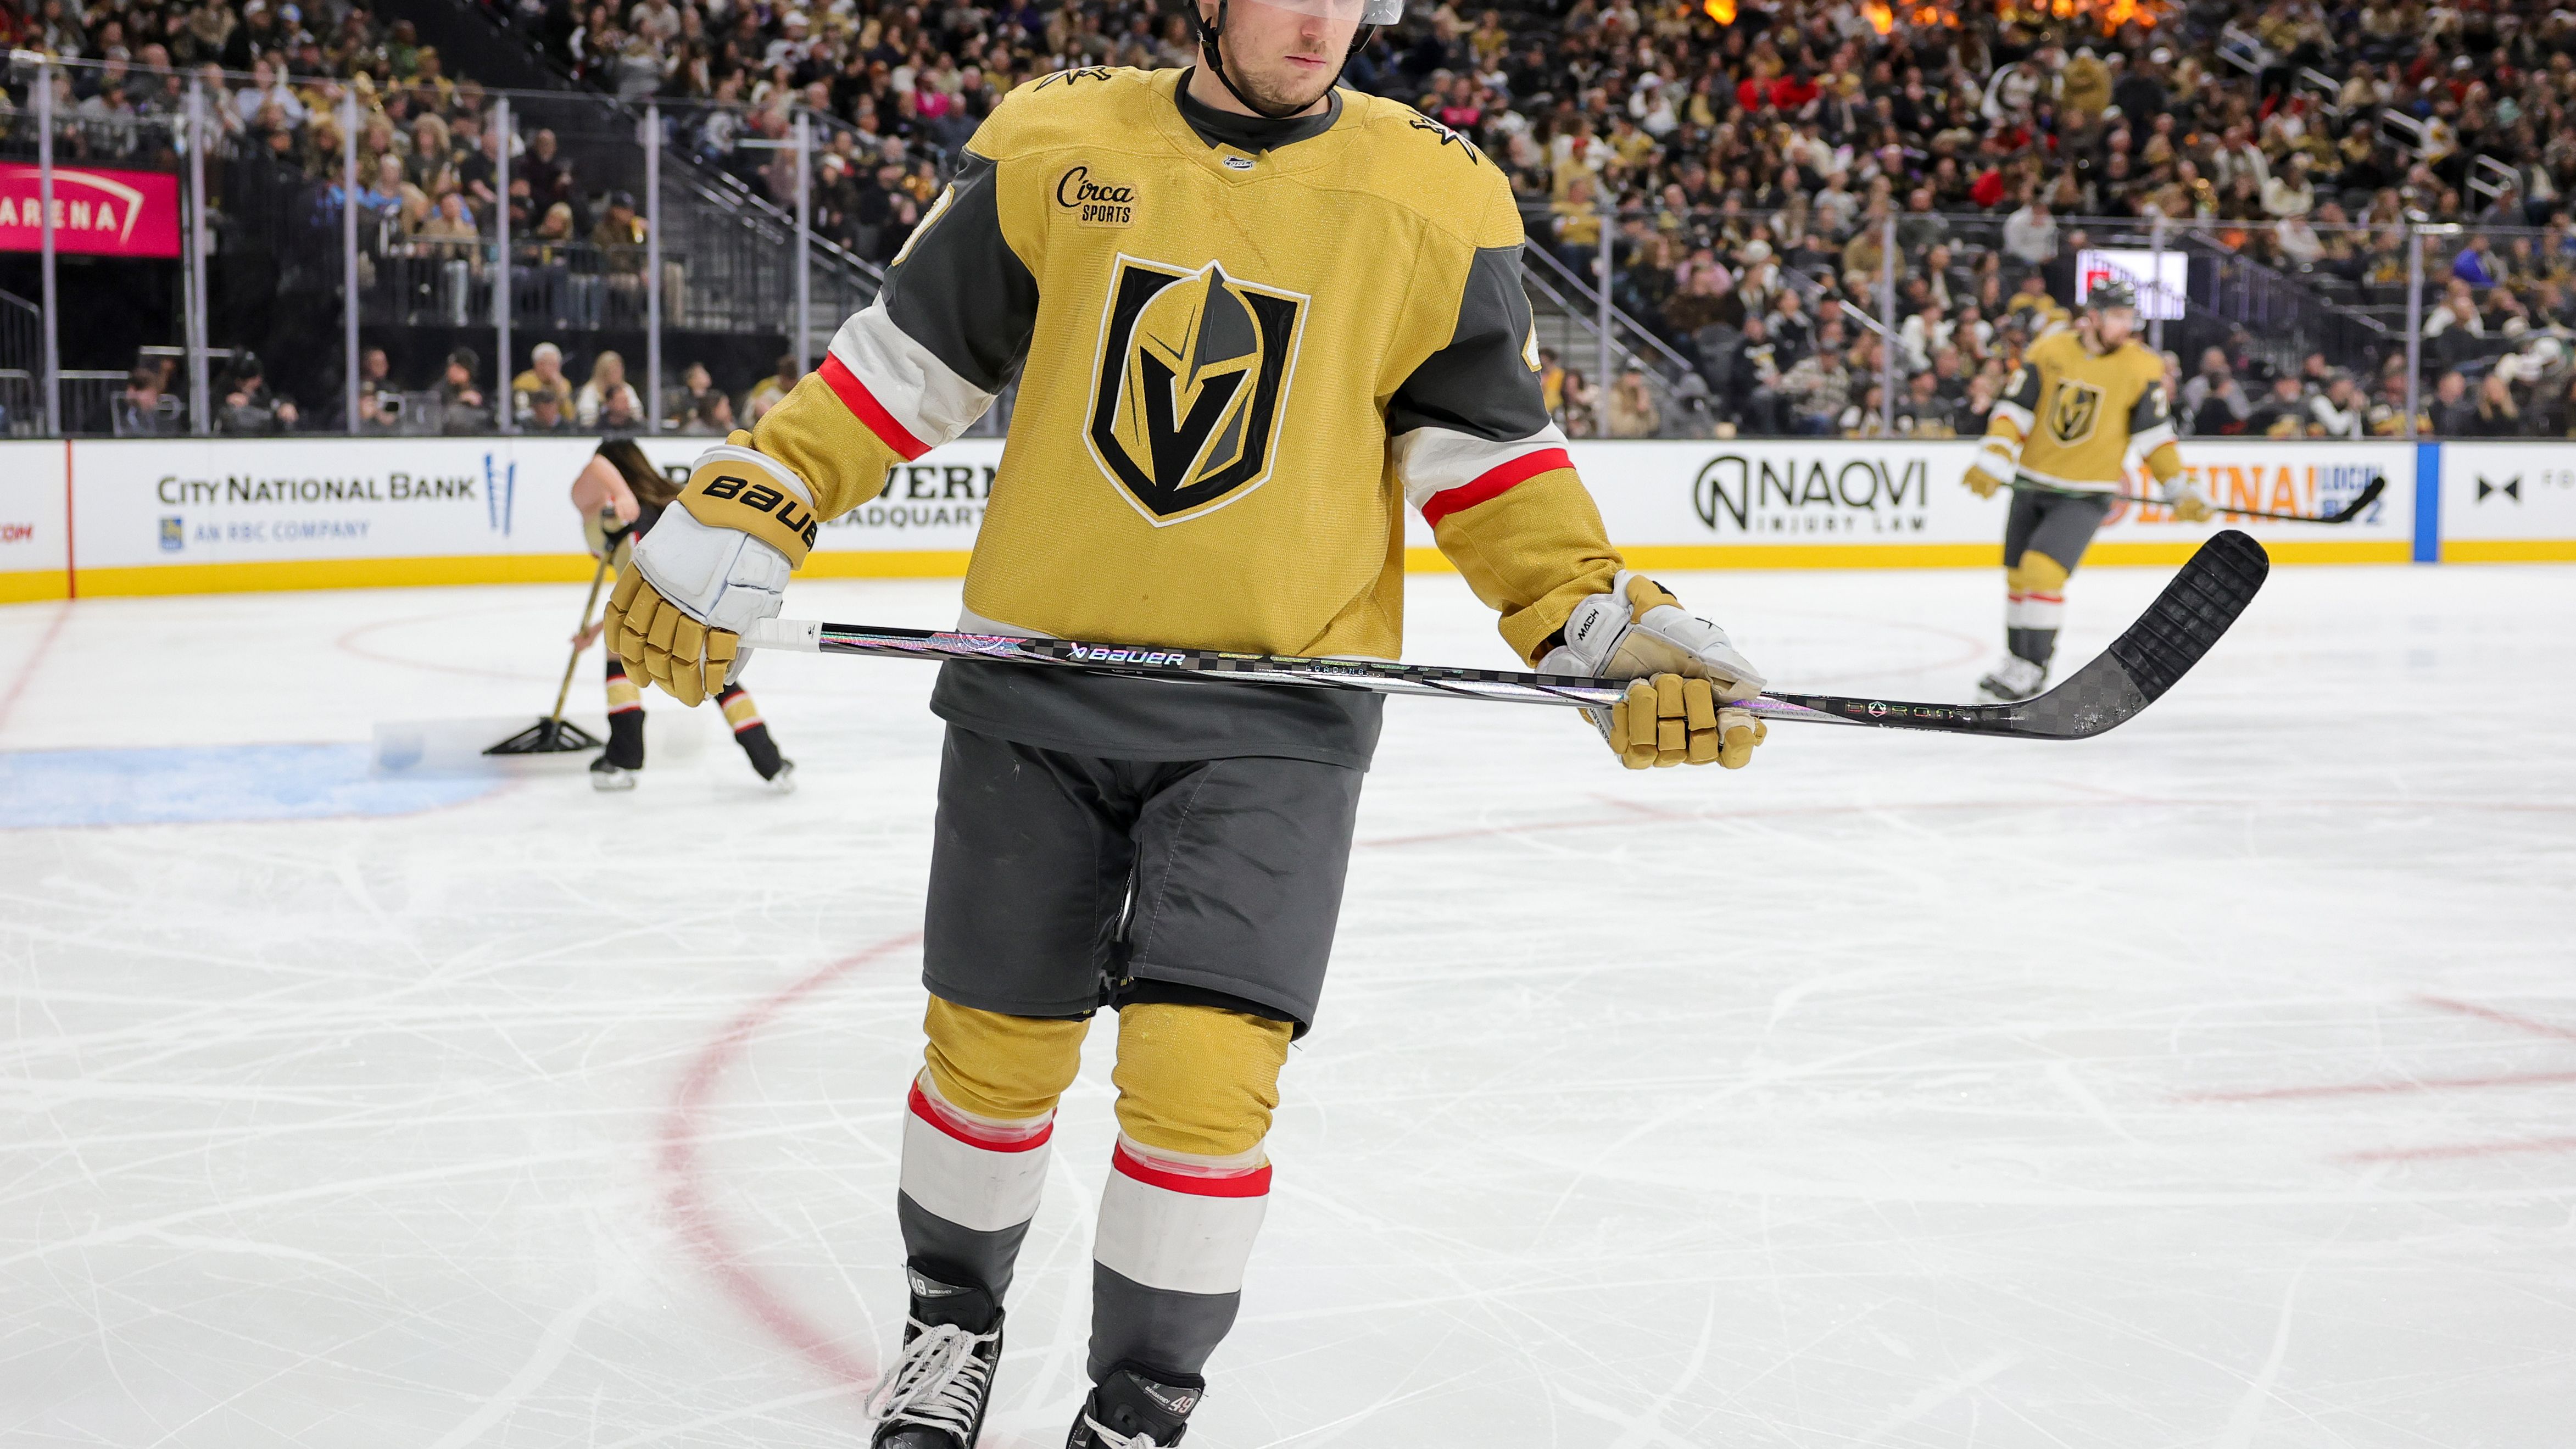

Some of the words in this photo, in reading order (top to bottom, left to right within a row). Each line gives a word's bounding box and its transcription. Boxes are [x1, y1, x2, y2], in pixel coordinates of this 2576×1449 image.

[1057, 166, 1134, 208] Circa
[0, 196, 118, 231] ARENA
[1082, 204, 1131, 223] SPORTS
[1760, 460, 1927, 511] NAQVI
[195, 522, 221, 541] AN
[227, 521, 268, 542] RBC
[271, 519, 370, 542] COMPANY
[1758, 515, 1857, 533] INJURY
[1873, 515, 1927, 532] LAW
[1576, 608, 1599, 642] MACH
[911, 1276, 927, 1296] 49
[1169, 1396, 1195, 1414] 49
